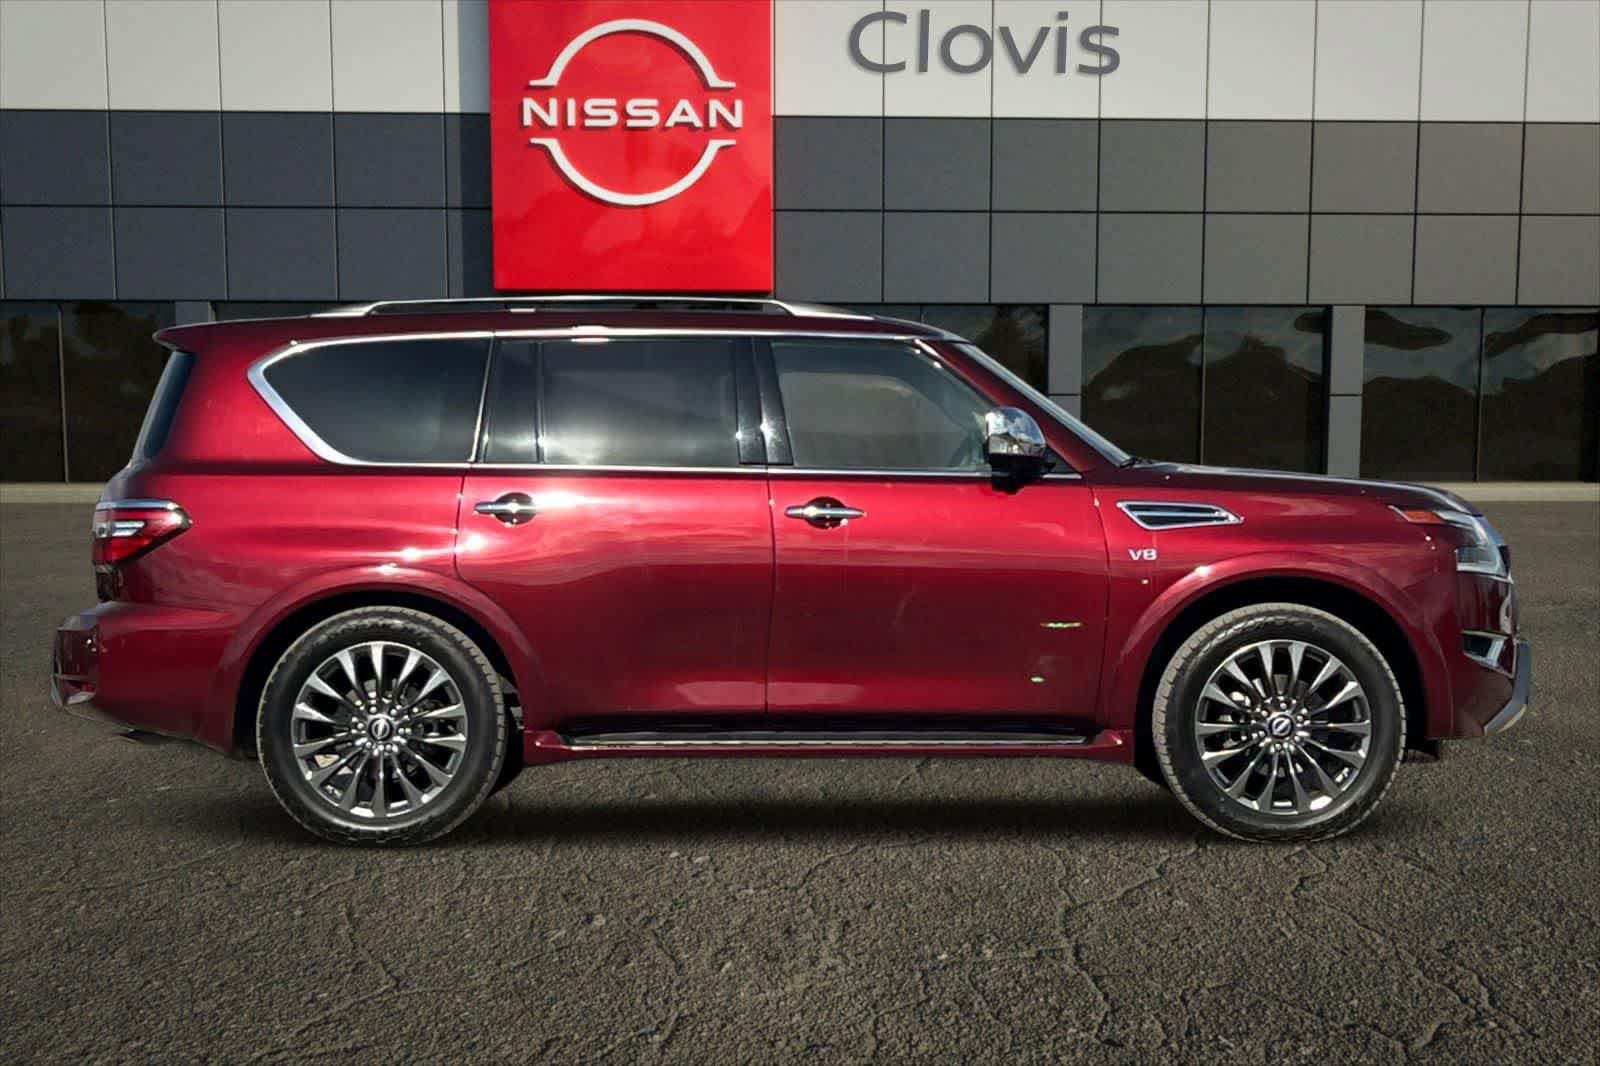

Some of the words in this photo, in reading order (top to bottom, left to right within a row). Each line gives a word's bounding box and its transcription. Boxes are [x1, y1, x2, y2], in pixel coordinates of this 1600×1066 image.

[849, 9, 1121, 75] Clovis
[522, 97, 743, 128] NISSAN
[1128, 548, 1157, 561] V8
